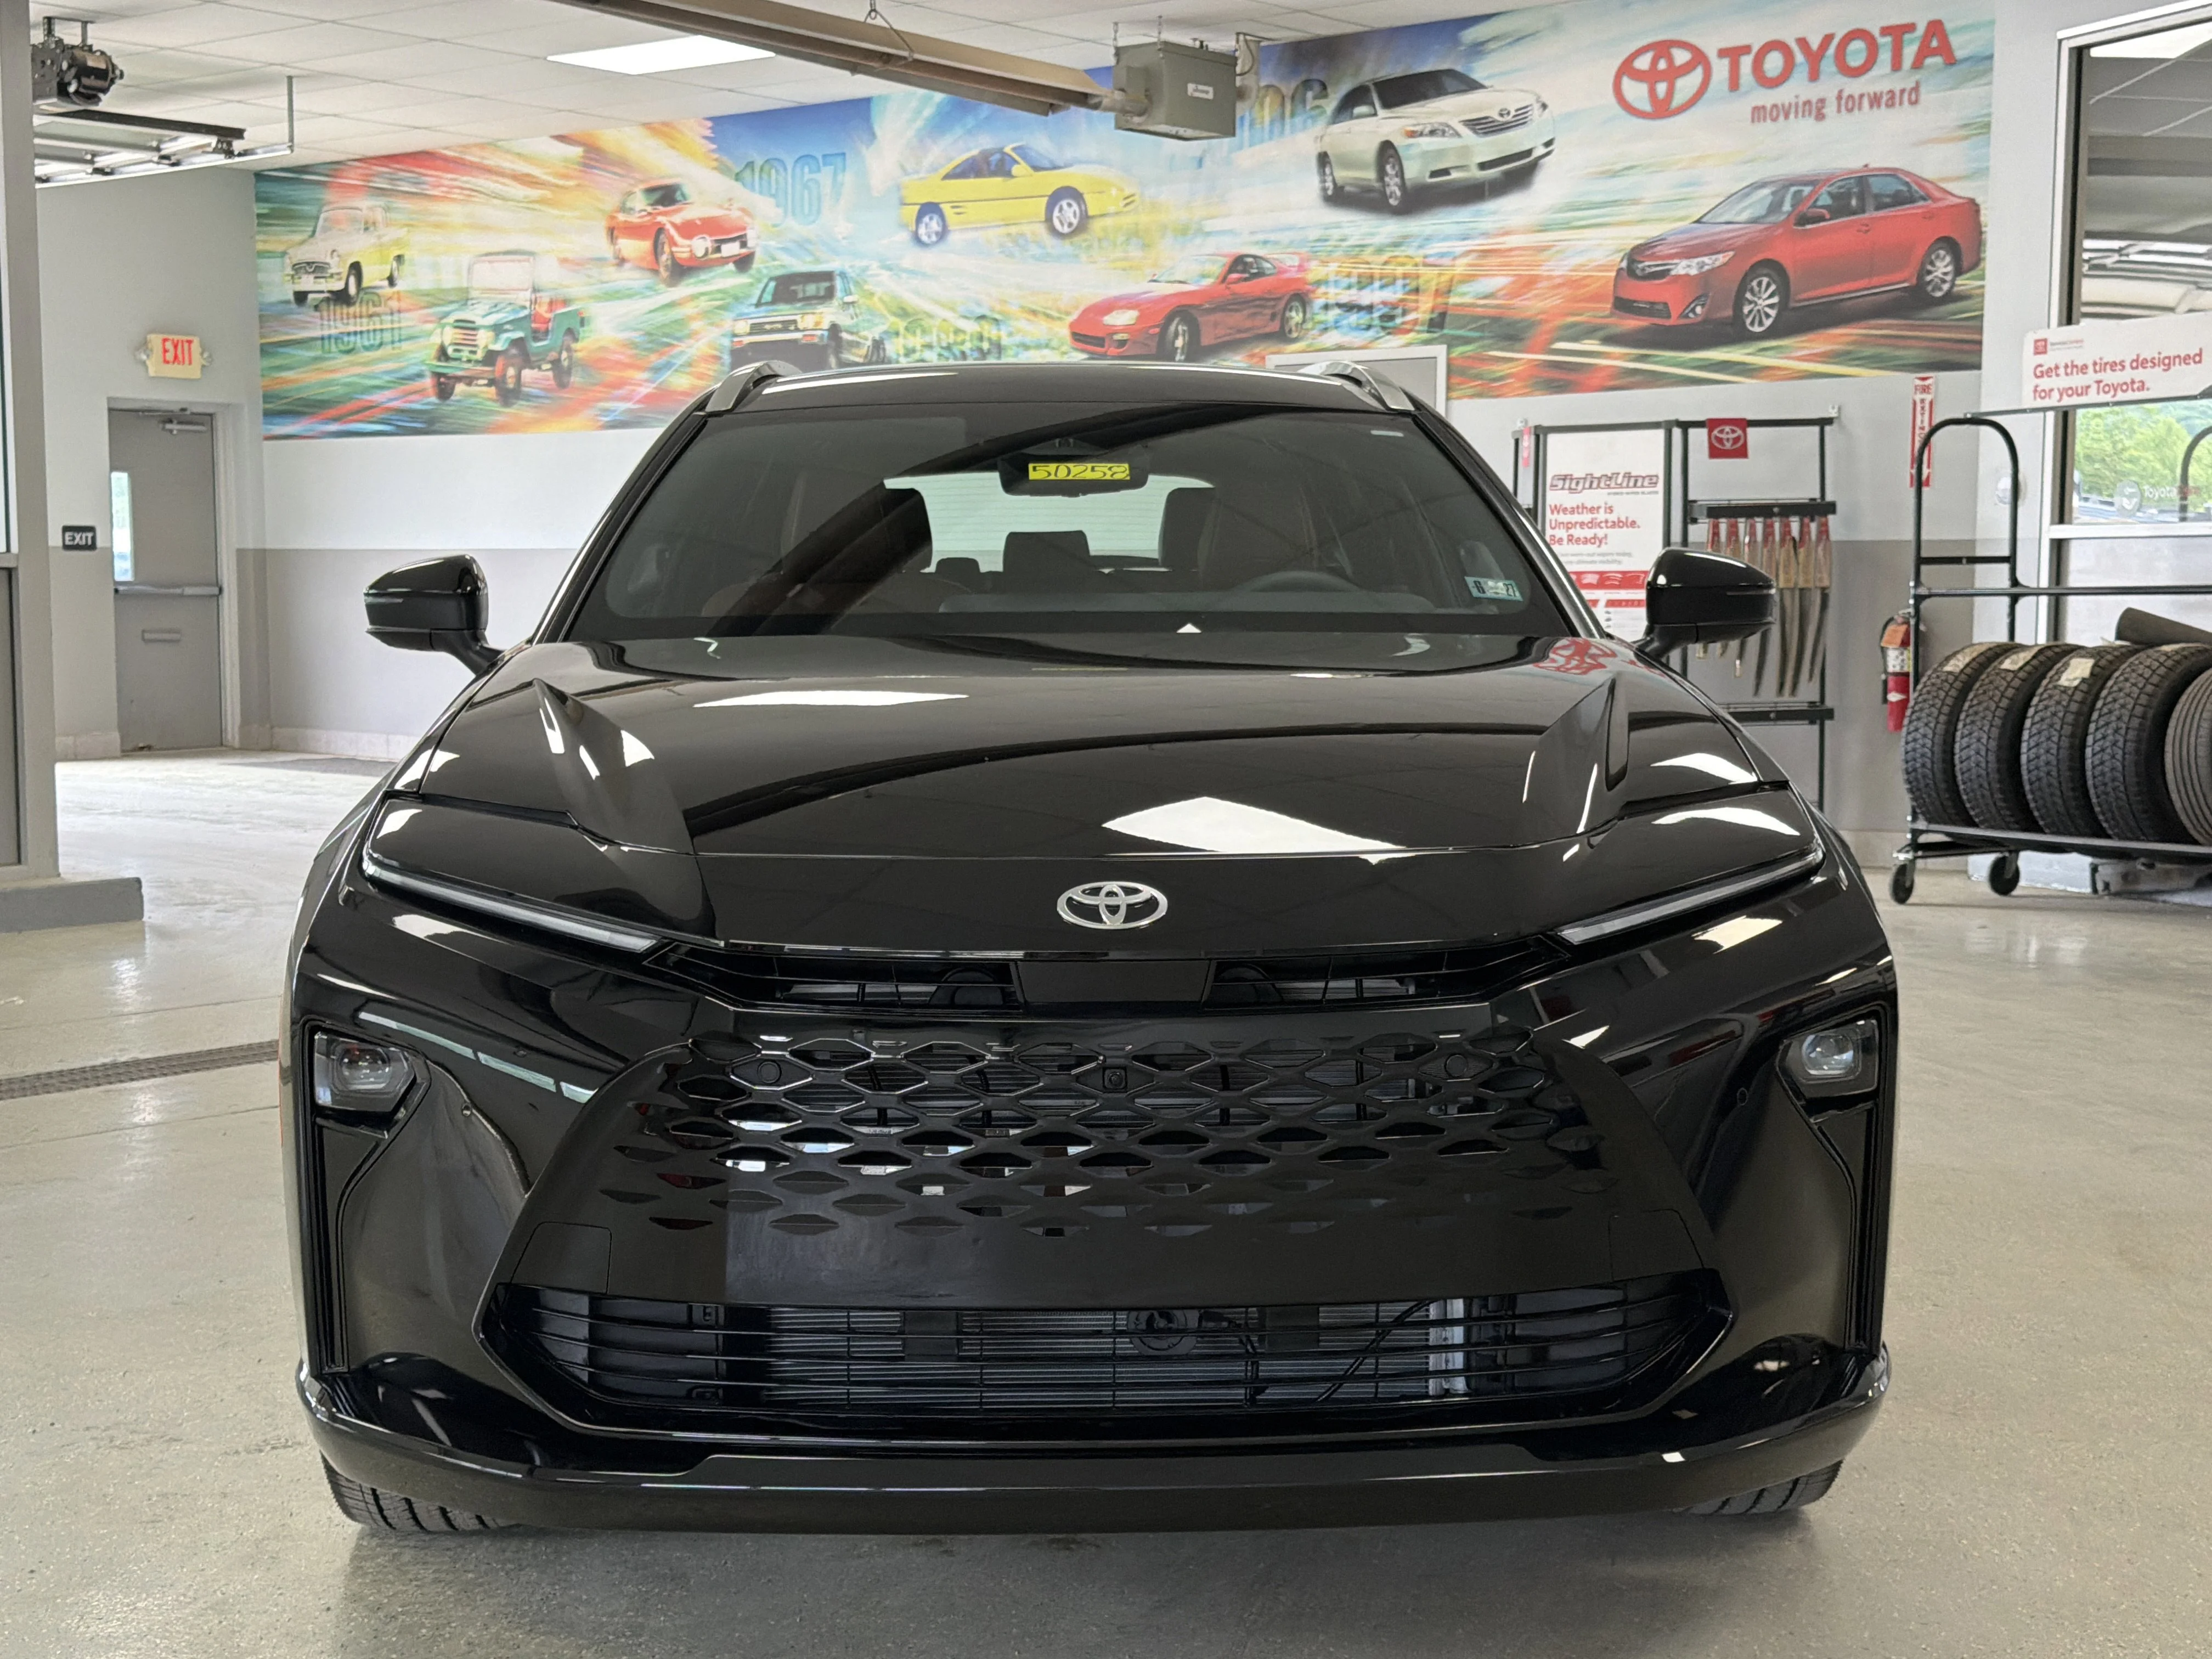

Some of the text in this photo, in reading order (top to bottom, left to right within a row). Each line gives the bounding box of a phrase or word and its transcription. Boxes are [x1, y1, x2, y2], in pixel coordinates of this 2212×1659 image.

[1718, 19, 1957, 92] TOYOTA
[1751, 82, 1920, 124] moving forward
[735, 152, 846, 229] 1967
[314, 291, 403, 354] 1961
[162, 337, 194, 366] EXIT
[2033, 347, 2203, 379] Get the tires designed
[1914, 385, 1932, 394] FIRE
[2032, 378, 2151, 402] for your Toyota.
[1032, 464, 1130, 479] 50258
[1549, 472, 1659, 494] SightLine
[1549, 501, 1614, 516] Weather is
[1549, 517, 1641, 533] Unpredictable.
[65, 531, 94, 546] EXIT
[1549, 533, 1608, 548] Be Ready!
